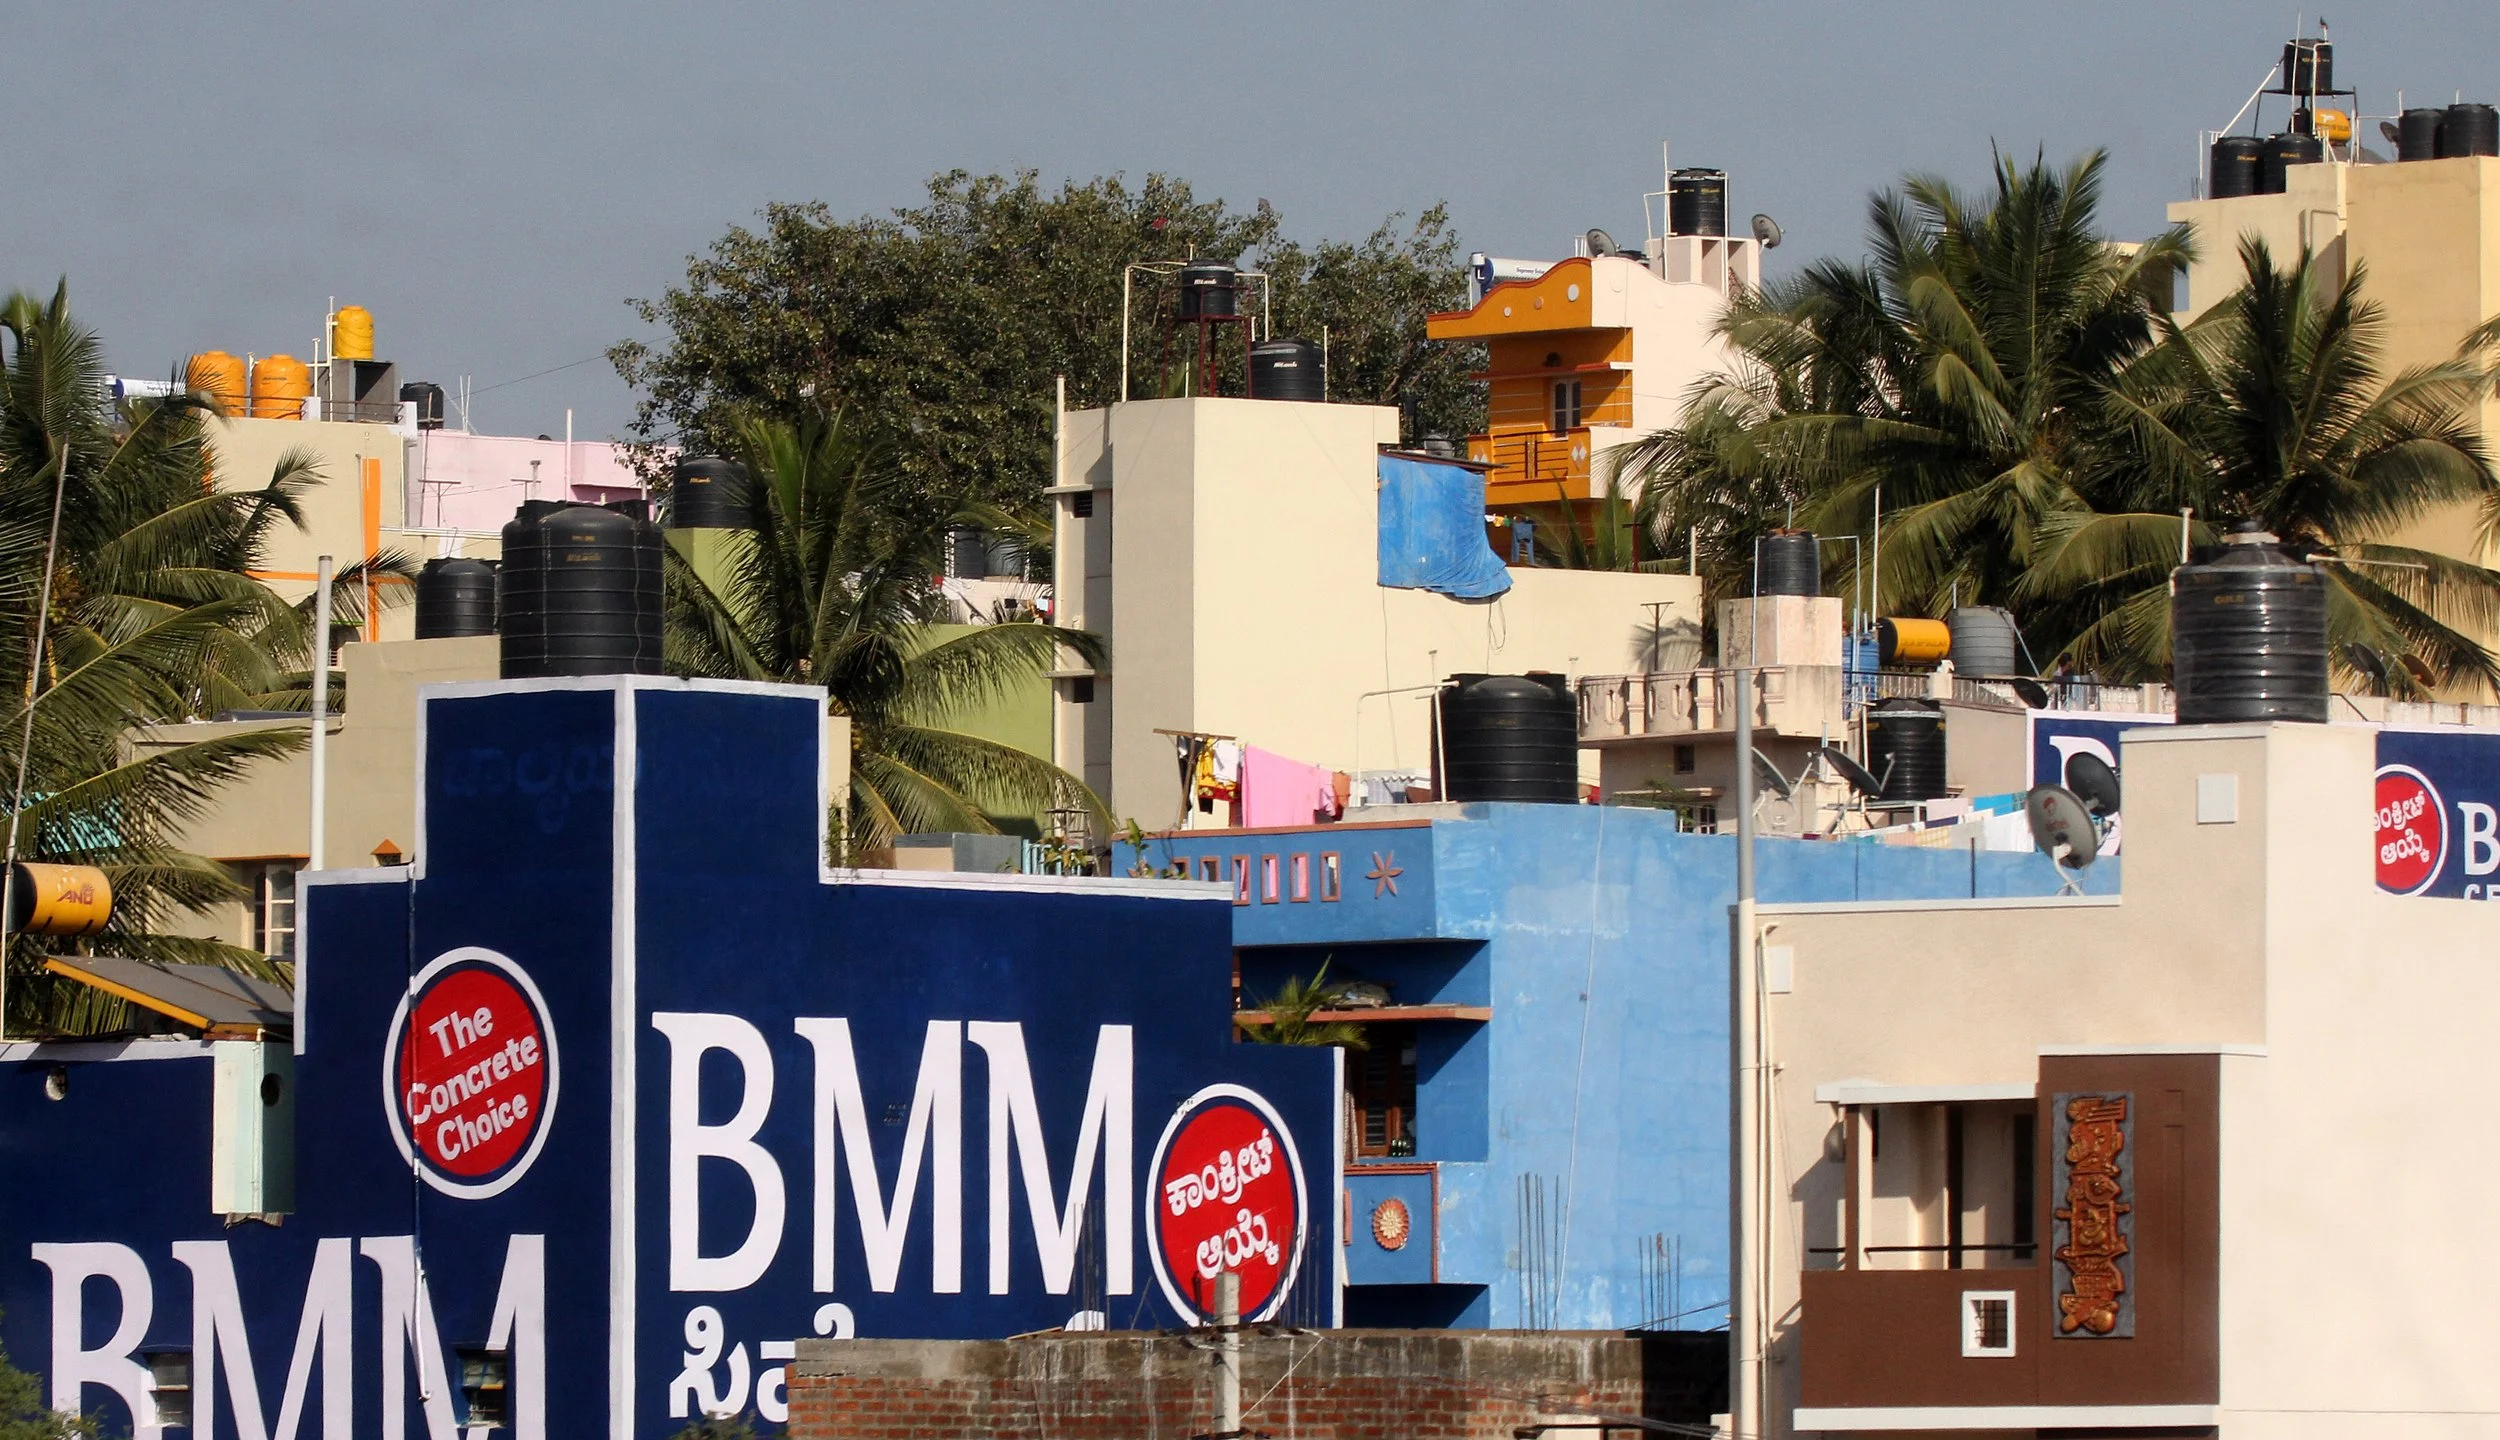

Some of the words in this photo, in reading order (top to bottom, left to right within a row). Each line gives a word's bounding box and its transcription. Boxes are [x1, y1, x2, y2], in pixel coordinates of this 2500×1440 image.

[2380, 828, 2430, 865] ಆಯ್ಕೆ
[429, 1006, 494, 1058] The
[406, 1035, 540, 1125] Concrete
[436, 1093, 529, 1161] Choice
[651, 1011, 1134, 1296] BMM
[1165, 1127, 1274, 1217] ಕಾಂಕ್ರೀಟ್
[1196, 1208, 1280, 1280] ಆಯ್ಕೆ
[31, 1234, 546, 1440] BMM
